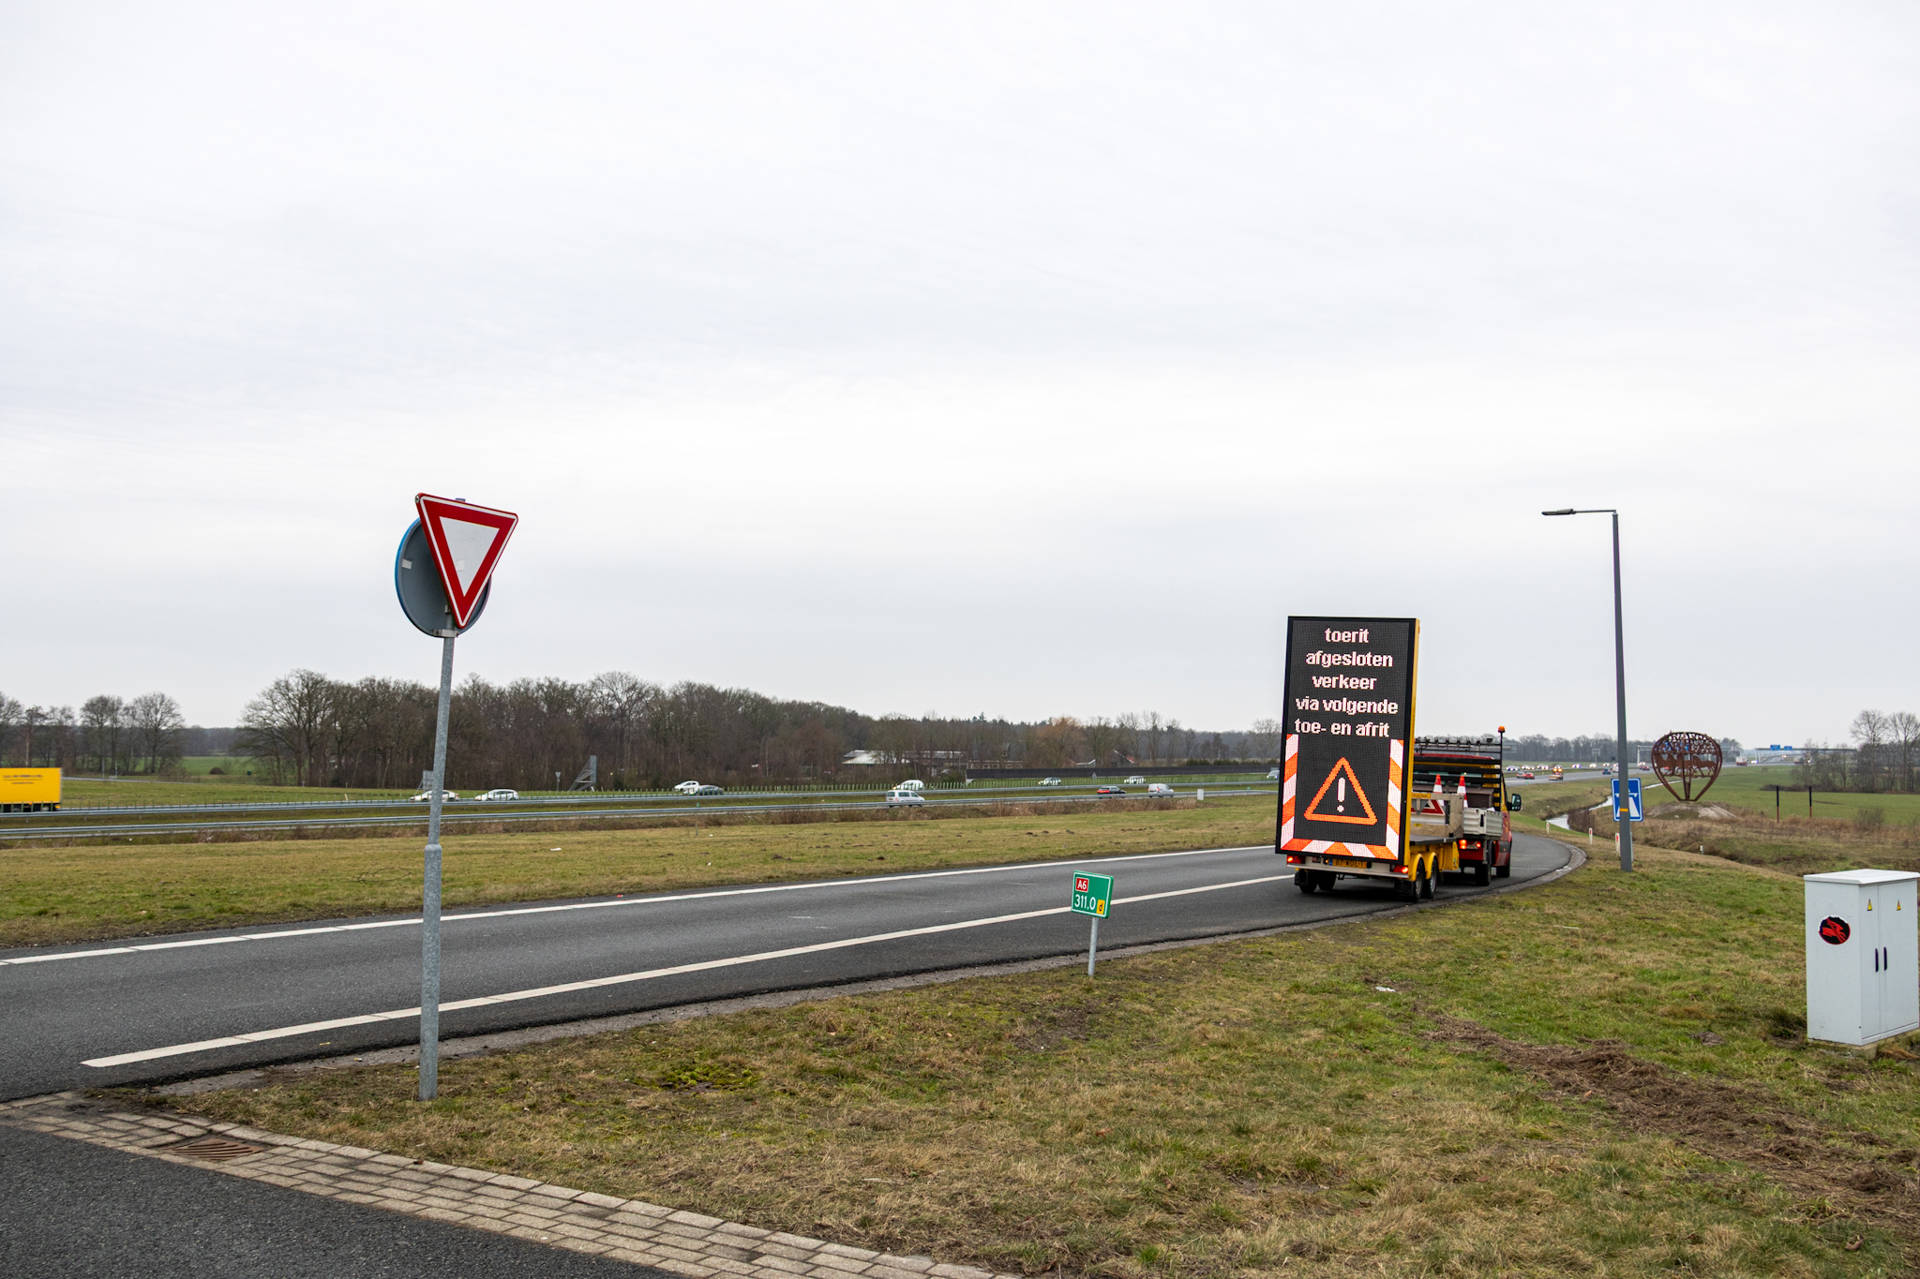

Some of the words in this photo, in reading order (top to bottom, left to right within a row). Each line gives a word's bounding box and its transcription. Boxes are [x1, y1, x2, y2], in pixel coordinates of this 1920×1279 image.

[1324, 627, 1370, 643] toerit
[1305, 650, 1393, 668] afgesloten
[1311, 674, 1378, 690] verkeer
[1295, 695, 1320, 711] via
[1322, 696, 1399, 715] volgende
[1294, 718, 1327, 735] toe-
[1330, 722, 1352, 736] en
[1355, 721, 1390, 738] afrit
[1077, 879, 1087, 890] A6
[1074, 894, 1096, 910] 311.0
